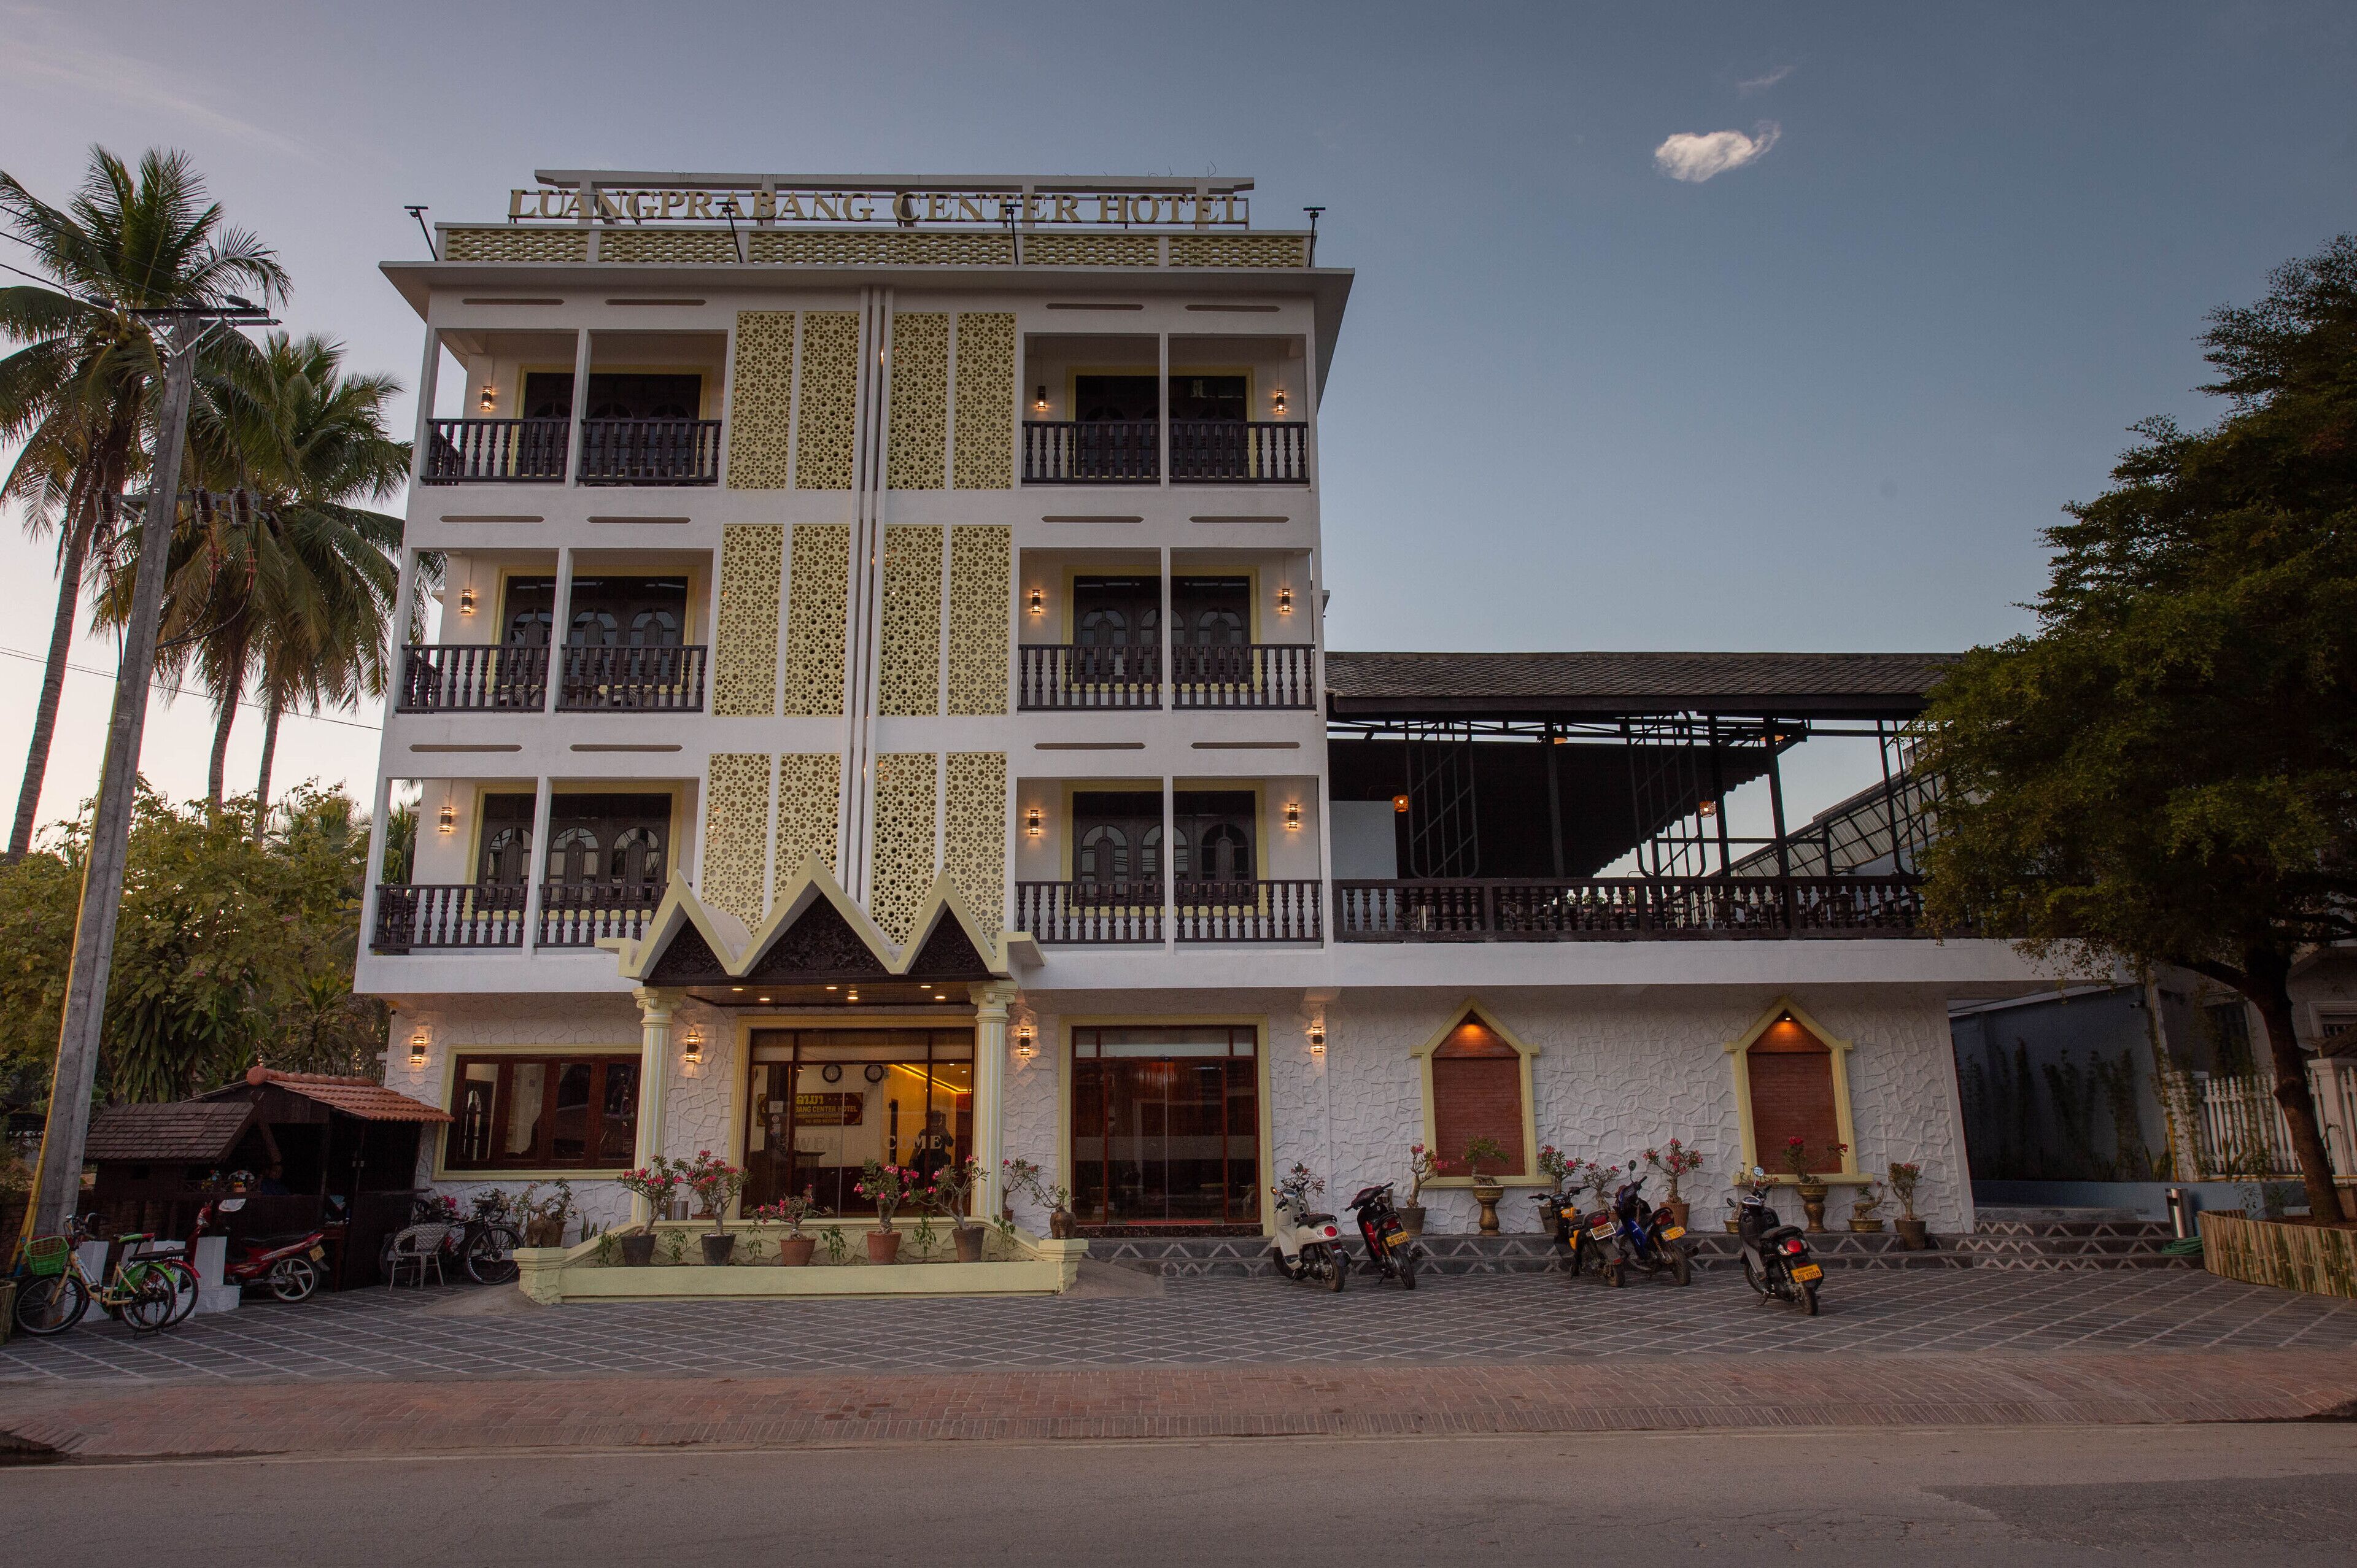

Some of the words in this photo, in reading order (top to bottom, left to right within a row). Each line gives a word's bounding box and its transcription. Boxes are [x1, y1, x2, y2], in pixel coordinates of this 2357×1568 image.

[509, 189, 874, 222] LUANGPRABANG
[892, 192, 1082, 222] CENTER
[1097, 195, 1249, 223] HOTEL
